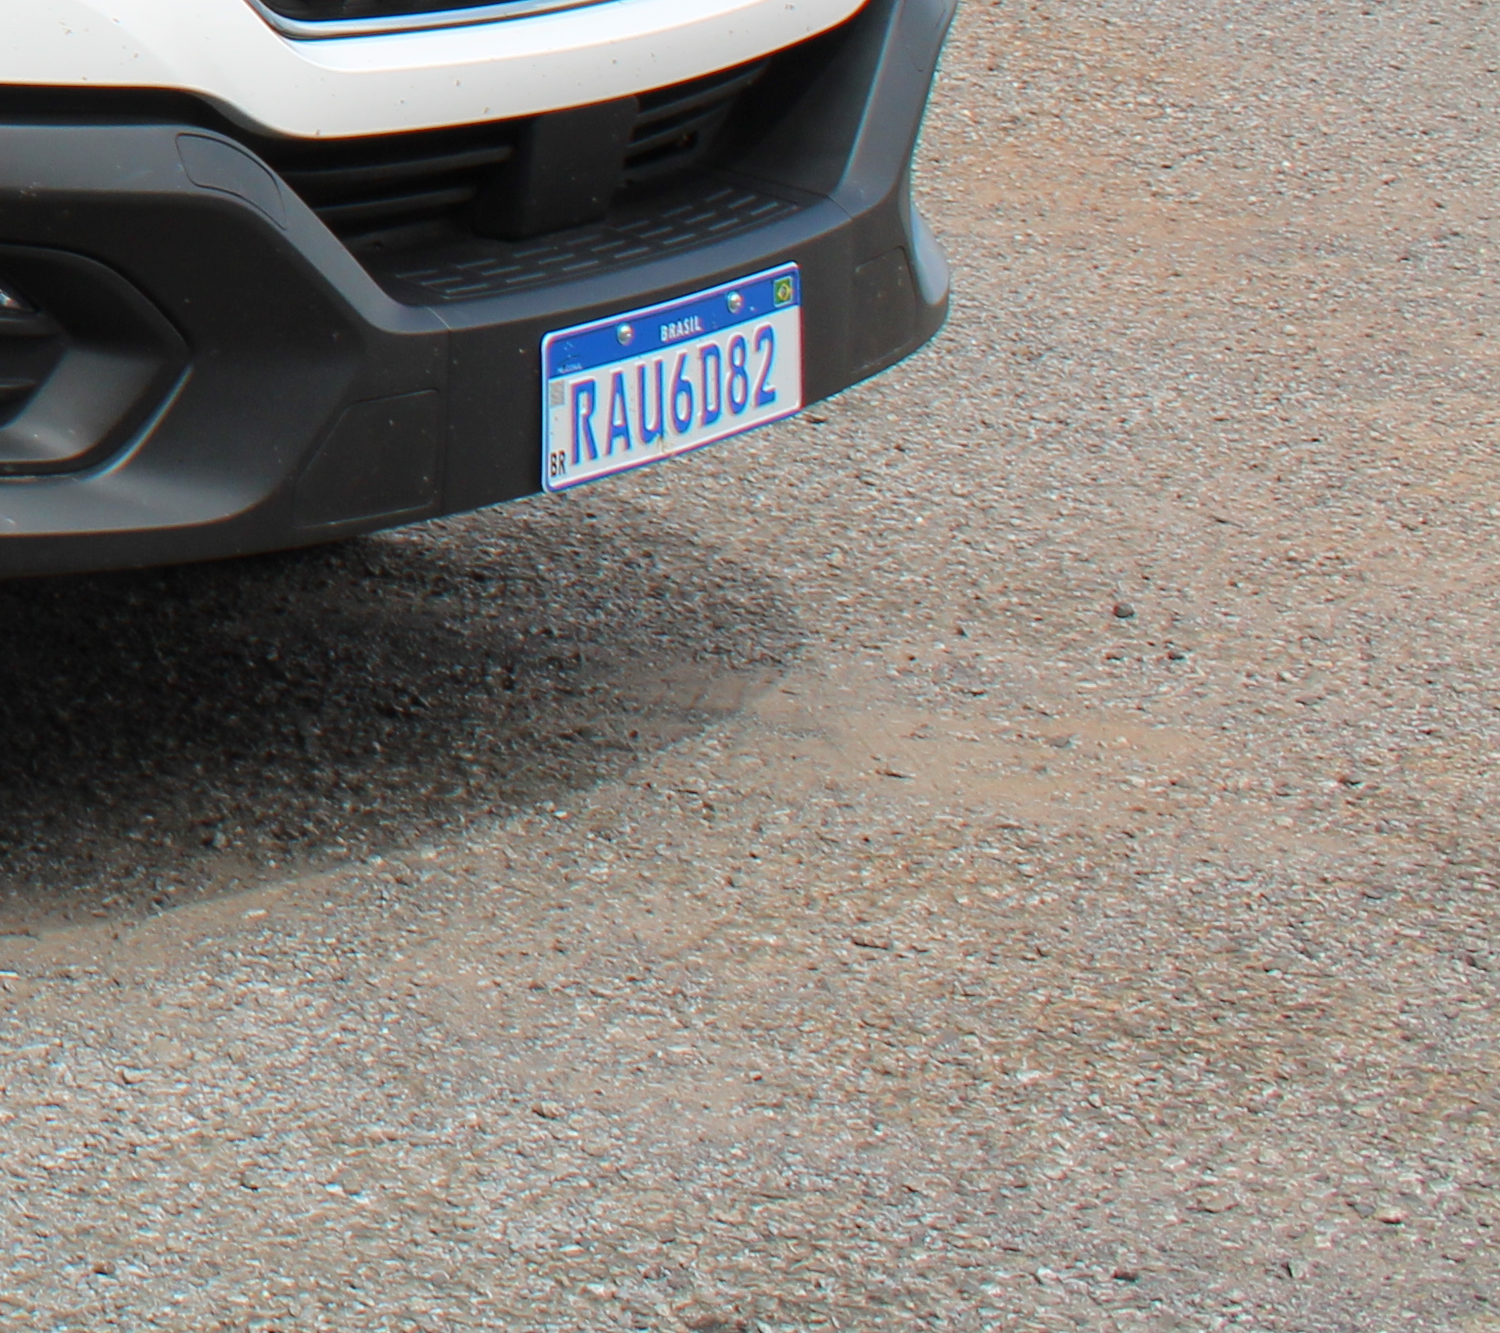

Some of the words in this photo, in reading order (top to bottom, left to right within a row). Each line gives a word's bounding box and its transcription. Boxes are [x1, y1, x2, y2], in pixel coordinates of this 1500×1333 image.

[660, 315, 703, 342] BRASIL
[568, 322, 778, 466] RAU6D82
[550, 449, 566, 477] BR
